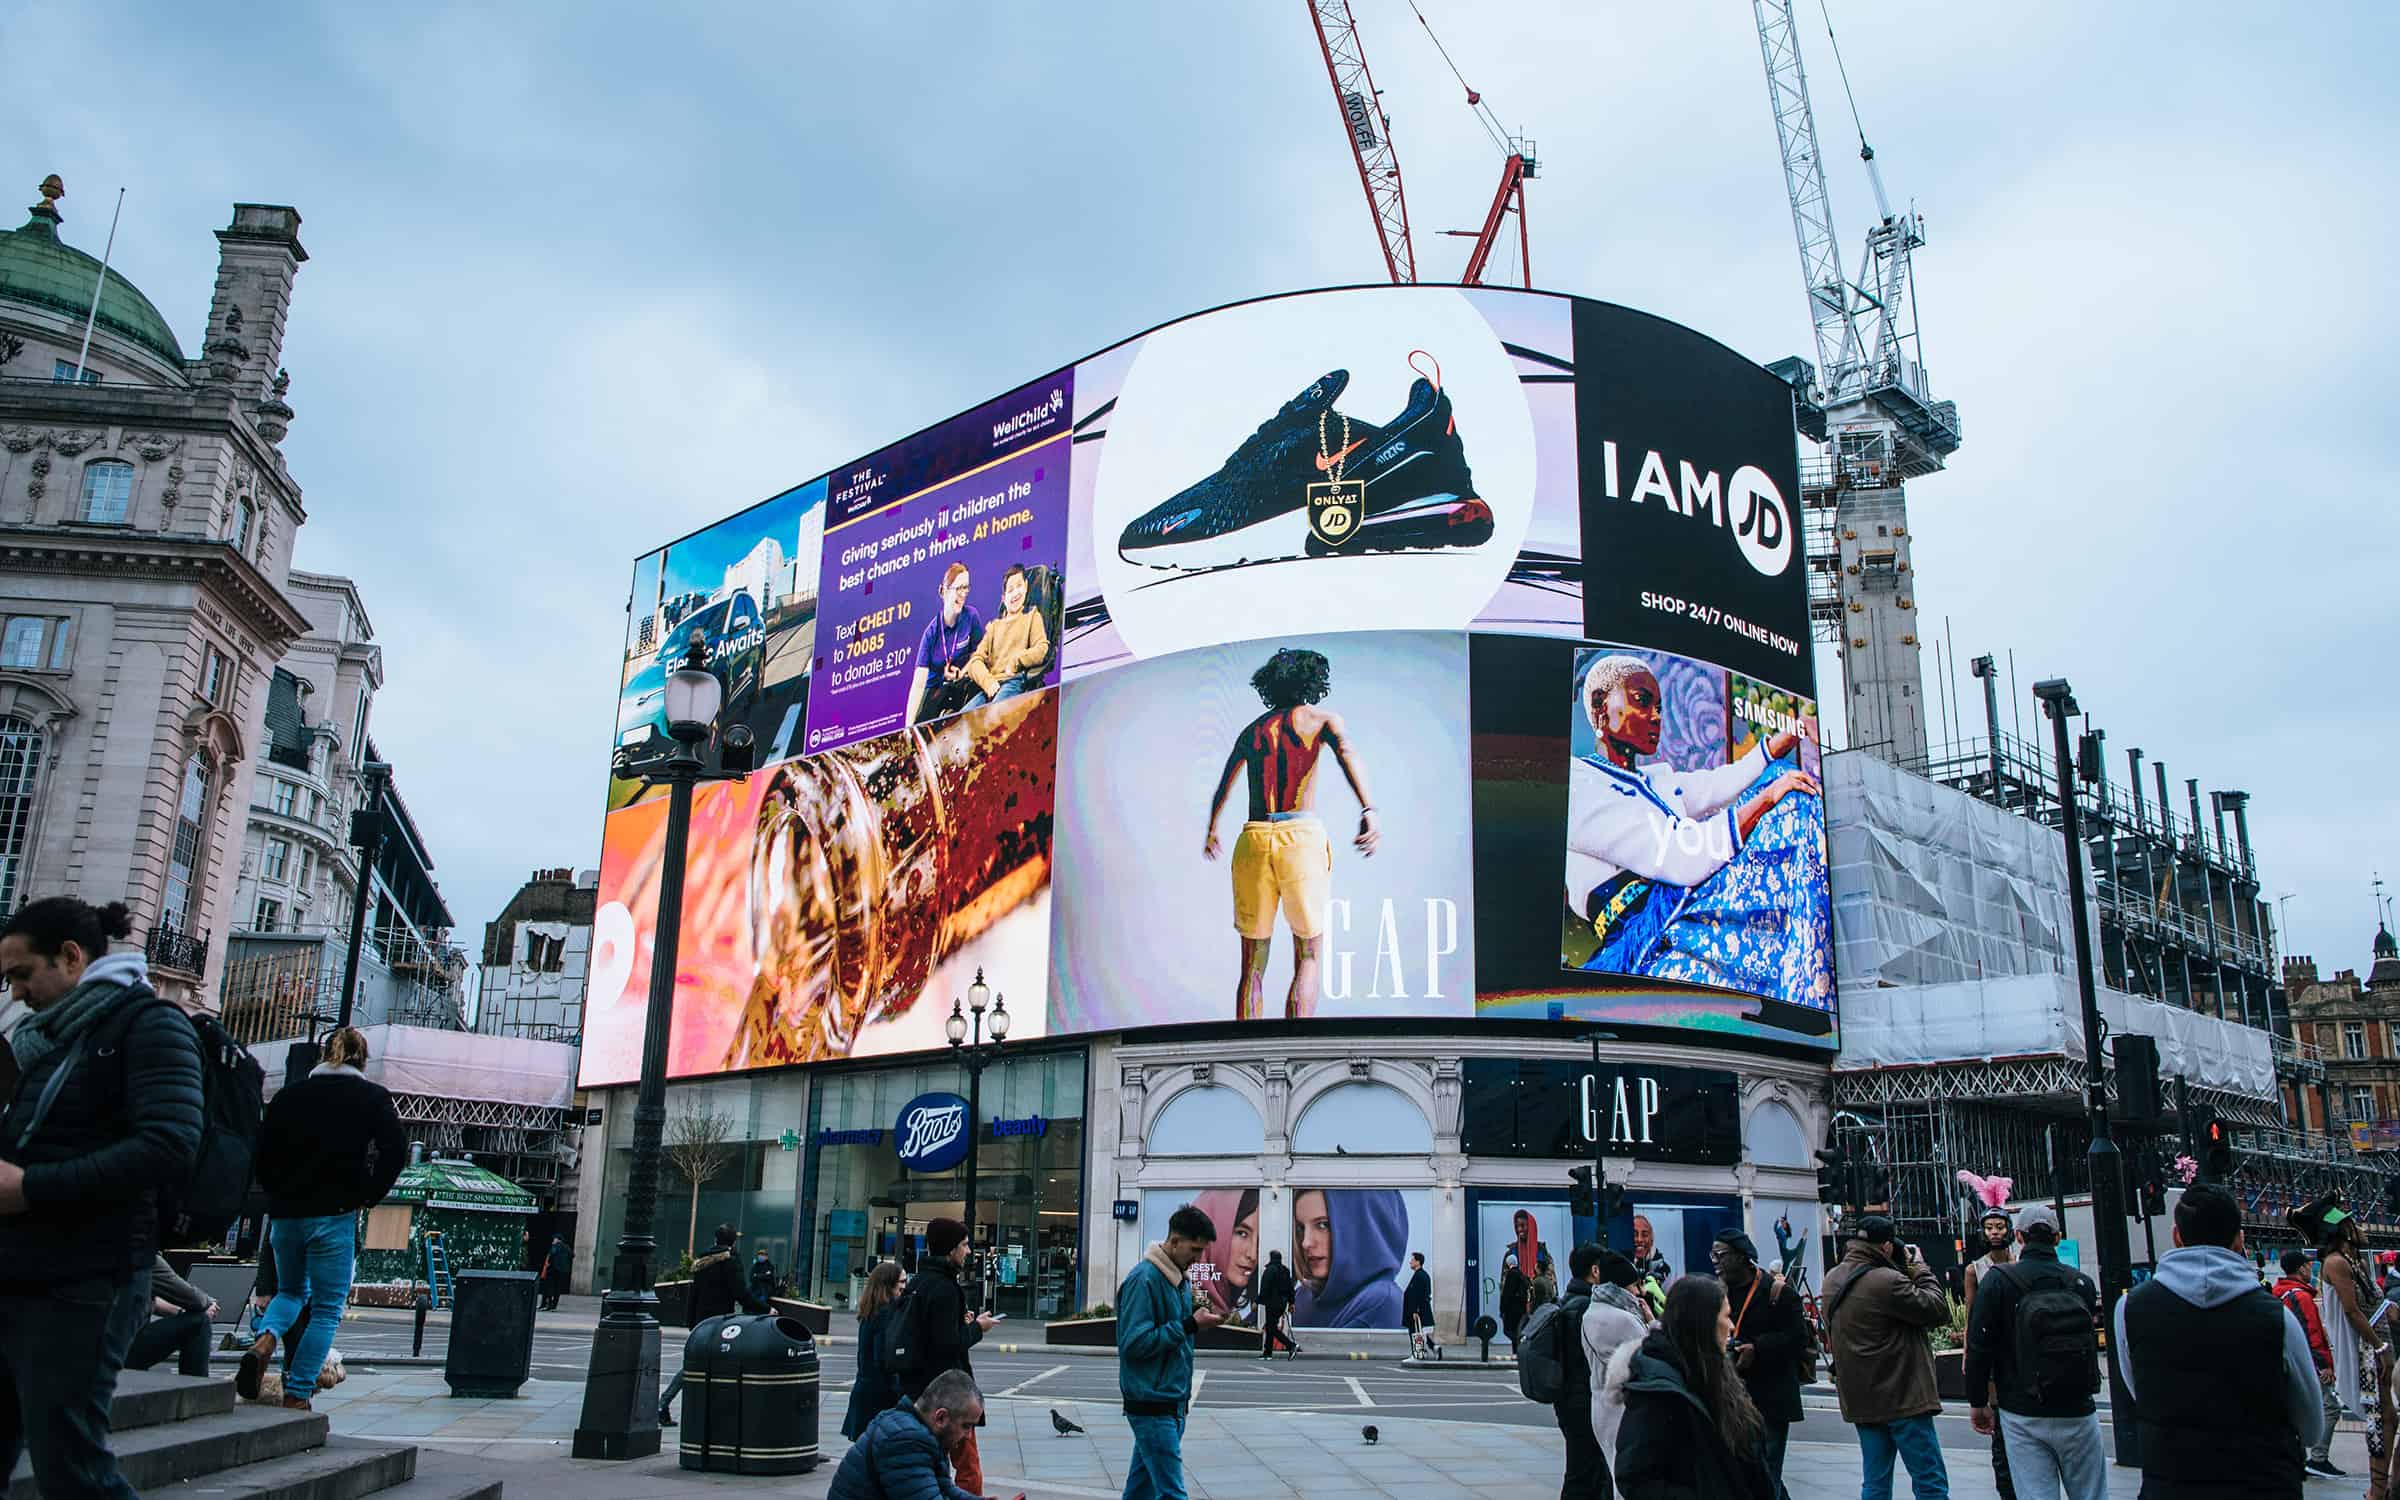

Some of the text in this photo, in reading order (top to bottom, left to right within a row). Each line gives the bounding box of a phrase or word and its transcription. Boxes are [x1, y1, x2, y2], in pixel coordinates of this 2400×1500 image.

[1346, 95, 1374, 148] WOLFF
[993, 402, 1049, 439] WellChild
[852, 468, 872, 485] THE
[1603, 440, 1619, 499] I
[1630, 449, 1723, 528] AM
[841, 480, 1032, 566] Giving seriously ill children the
[1324, 513, 1347, 528] JD
[839, 508, 1034, 592] best chance to thrive. At home.
[835, 601, 911, 641] Text CHELT 10
[1640, 591, 1799, 657] SHOP 24/7 ONLINE NOW
[715, 627, 764, 660] Awaits
[833, 632, 885, 665] to 70085
[831, 671, 842, 687] to
[844, 658, 884, 682] donate
[1734, 696, 1806, 740] SAMSUNG
[1647, 813, 1730, 867] you
[1322, 897, 1457, 1001] GAP
[992, 1114, 1048, 1138] beauty
[1581, 1073, 1659, 1144] GAP
[816, 1127, 884, 1147] pharmacy
[899, 1103, 964, 1159] Boots
[1200, 1272, 1209, 1281] IS
[1211, 1272, 1222, 1281] AT
